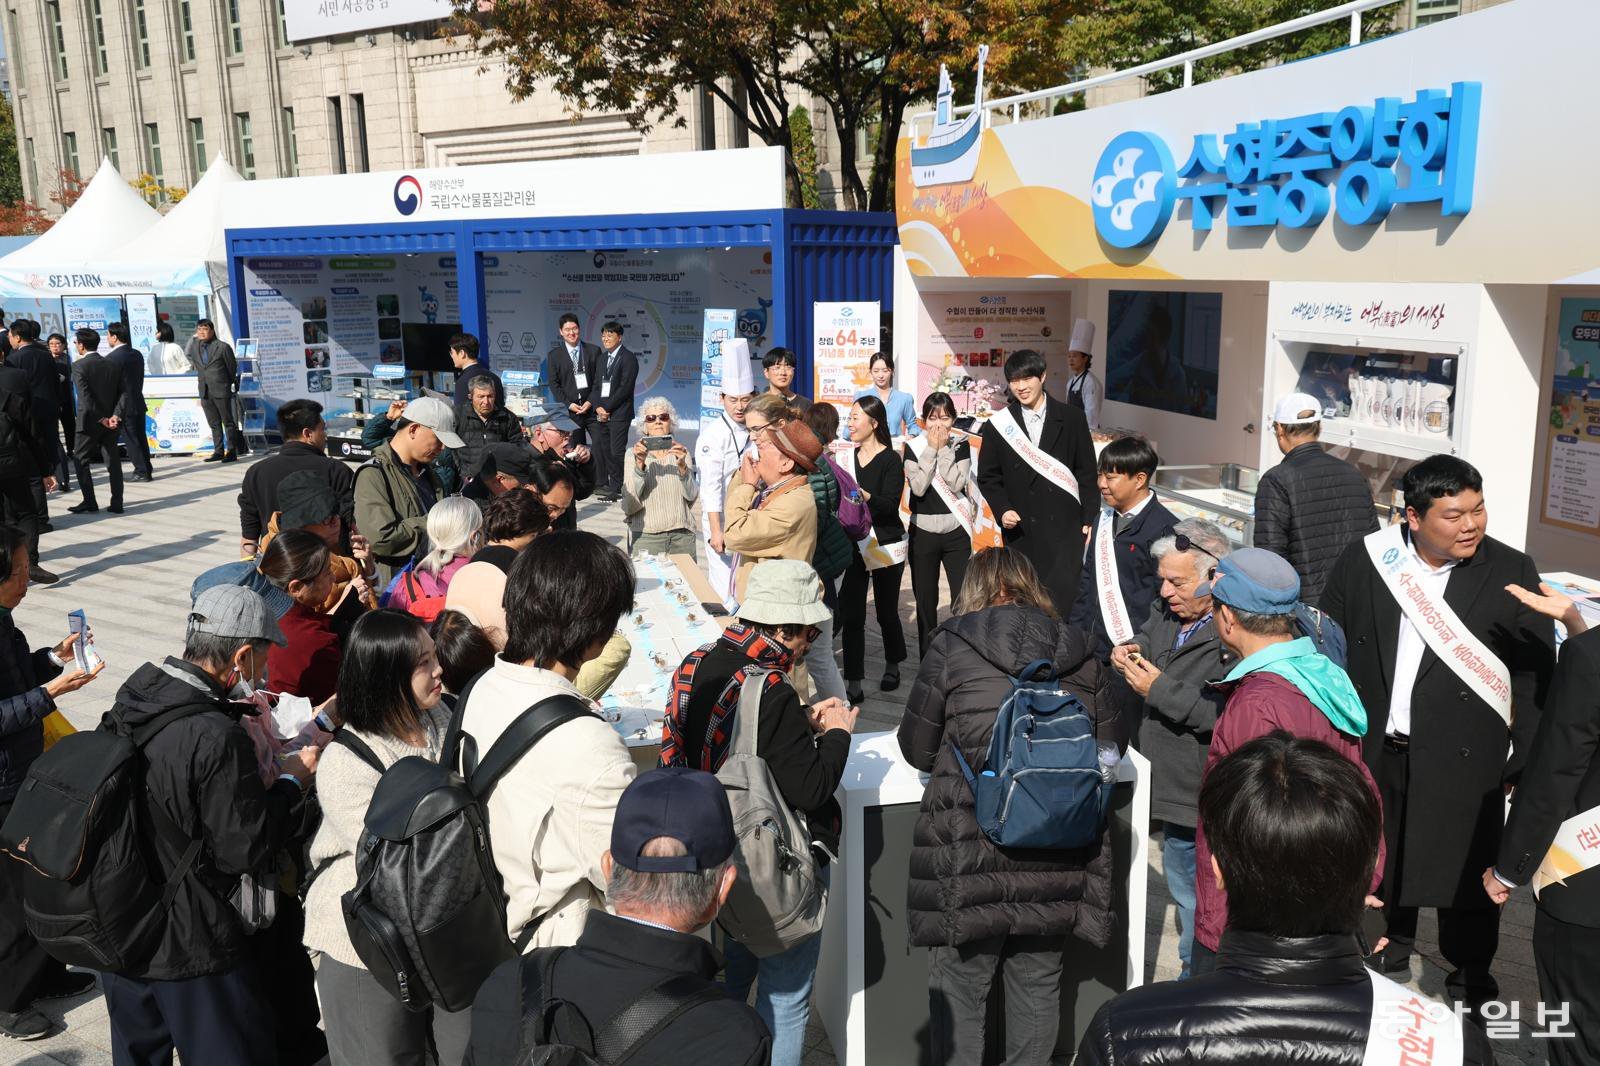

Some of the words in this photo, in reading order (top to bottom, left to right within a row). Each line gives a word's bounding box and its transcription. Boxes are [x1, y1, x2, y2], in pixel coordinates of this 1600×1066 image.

[1177, 81, 1482, 230] 수협중앙회
[429, 178, 464, 190] 해양수산부
[430, 190, 536, 209] 국립수산물품질관리원
[48, 274, 72, 288] SEA
[72, 273, 103, 288] FARM
[946, 306, 966, 315] 수협이
[968, 306, 988, 315] 만들어
[989, 306, 997, 315] 더
[998, 306, 1018, 315] 정직한
[1019, 306, 1046, 315] 수산식품
[1416, 303, 1445, 330] 세상
[831, 318, 863, 327] 수협중앙회
[818, 336, 834, 346] 창립
[835, 329, 858, 346] 64
[860, 336, 876, 346] 주년
[818, 348, 846, 359] 기념품
[848, 347, 876, 358] 이벤트
[172, 421, 199, 429] FARM
[1398, 571, 1459, 645] 수협중앙회
